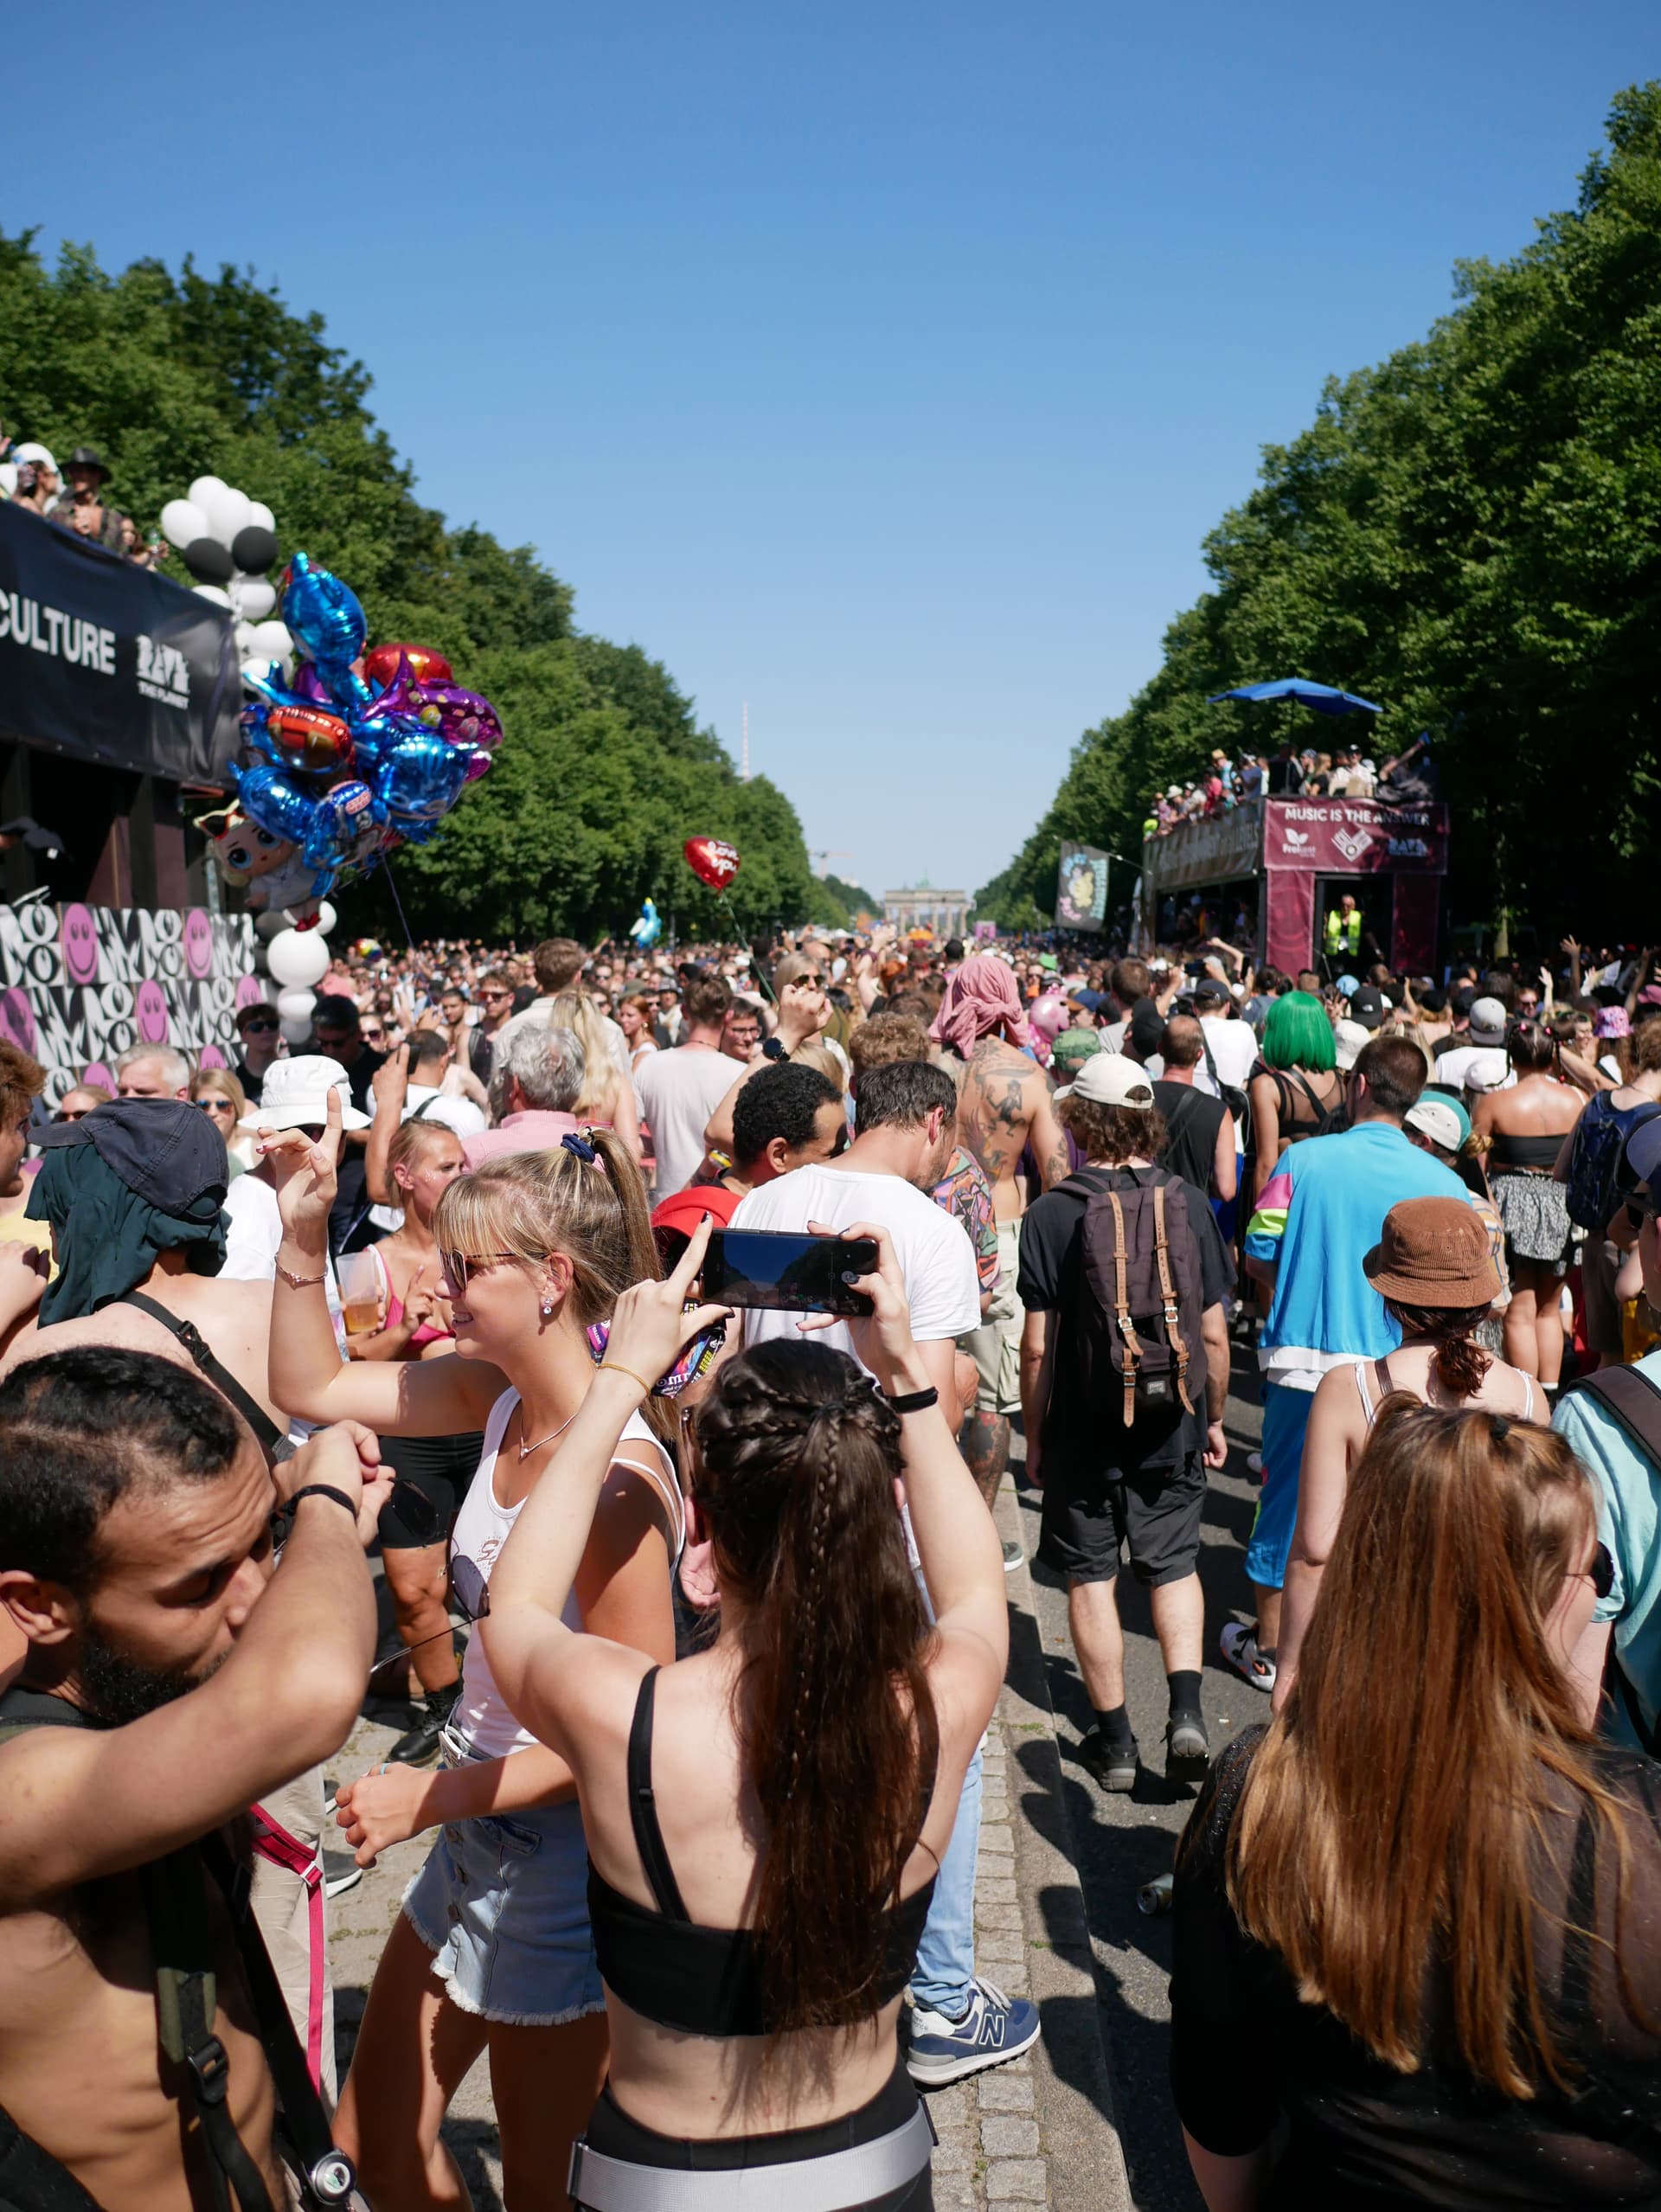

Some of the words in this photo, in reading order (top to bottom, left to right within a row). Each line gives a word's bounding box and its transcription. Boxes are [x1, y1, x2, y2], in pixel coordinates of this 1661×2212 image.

[1285, 808, 1327, 821] MUSIC
[1331, 809, 1341, 822] IS
[1344, 809, 1371, 823] THE
[1373, 813, 1430, 826] ANSWER
[978, 2014, 1004, 2047] N
